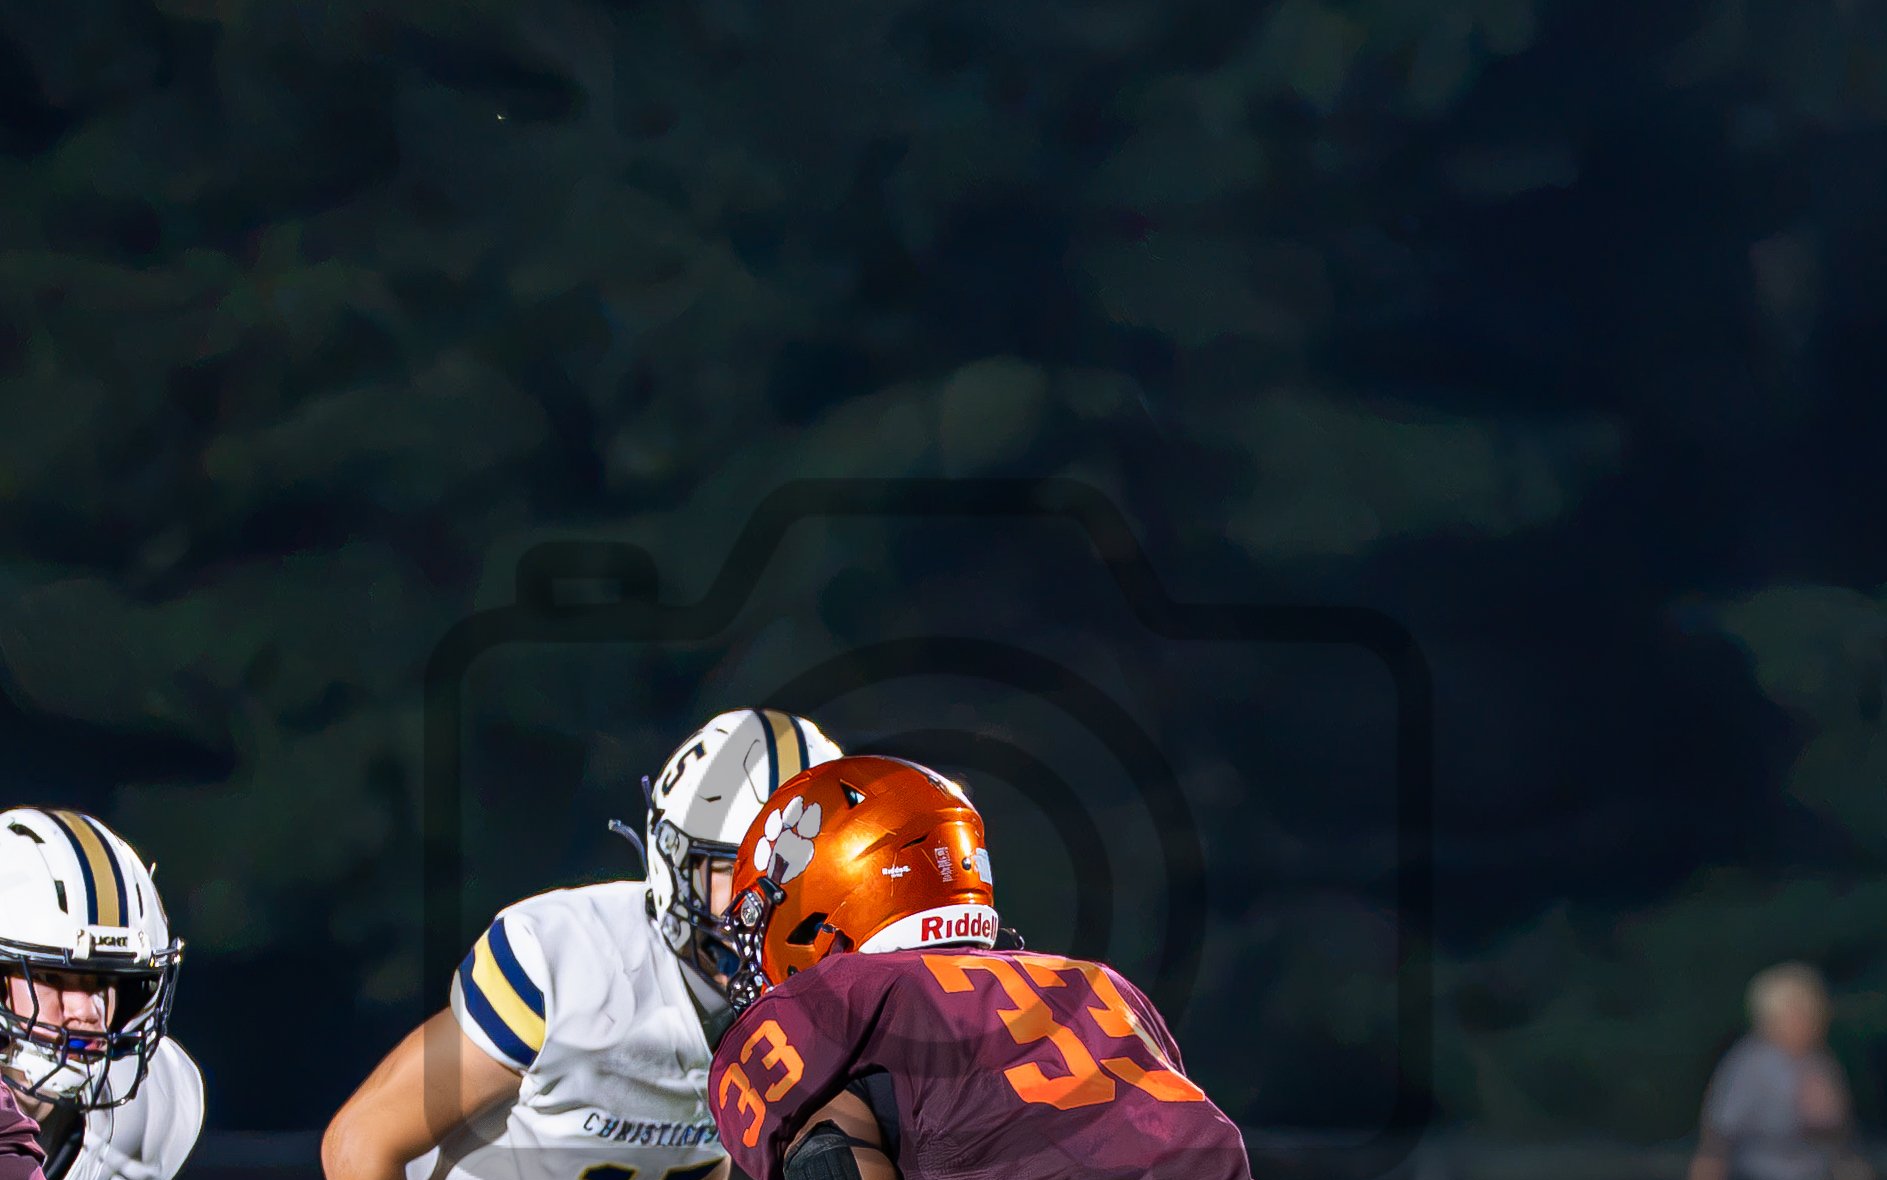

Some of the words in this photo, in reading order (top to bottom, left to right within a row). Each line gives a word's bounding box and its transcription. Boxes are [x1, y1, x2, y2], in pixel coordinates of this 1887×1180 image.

[921, 913, 998, 942] Riddell
[718, 1019, 805, 1148] 33
[920, 953, 1205, 1110] 33
